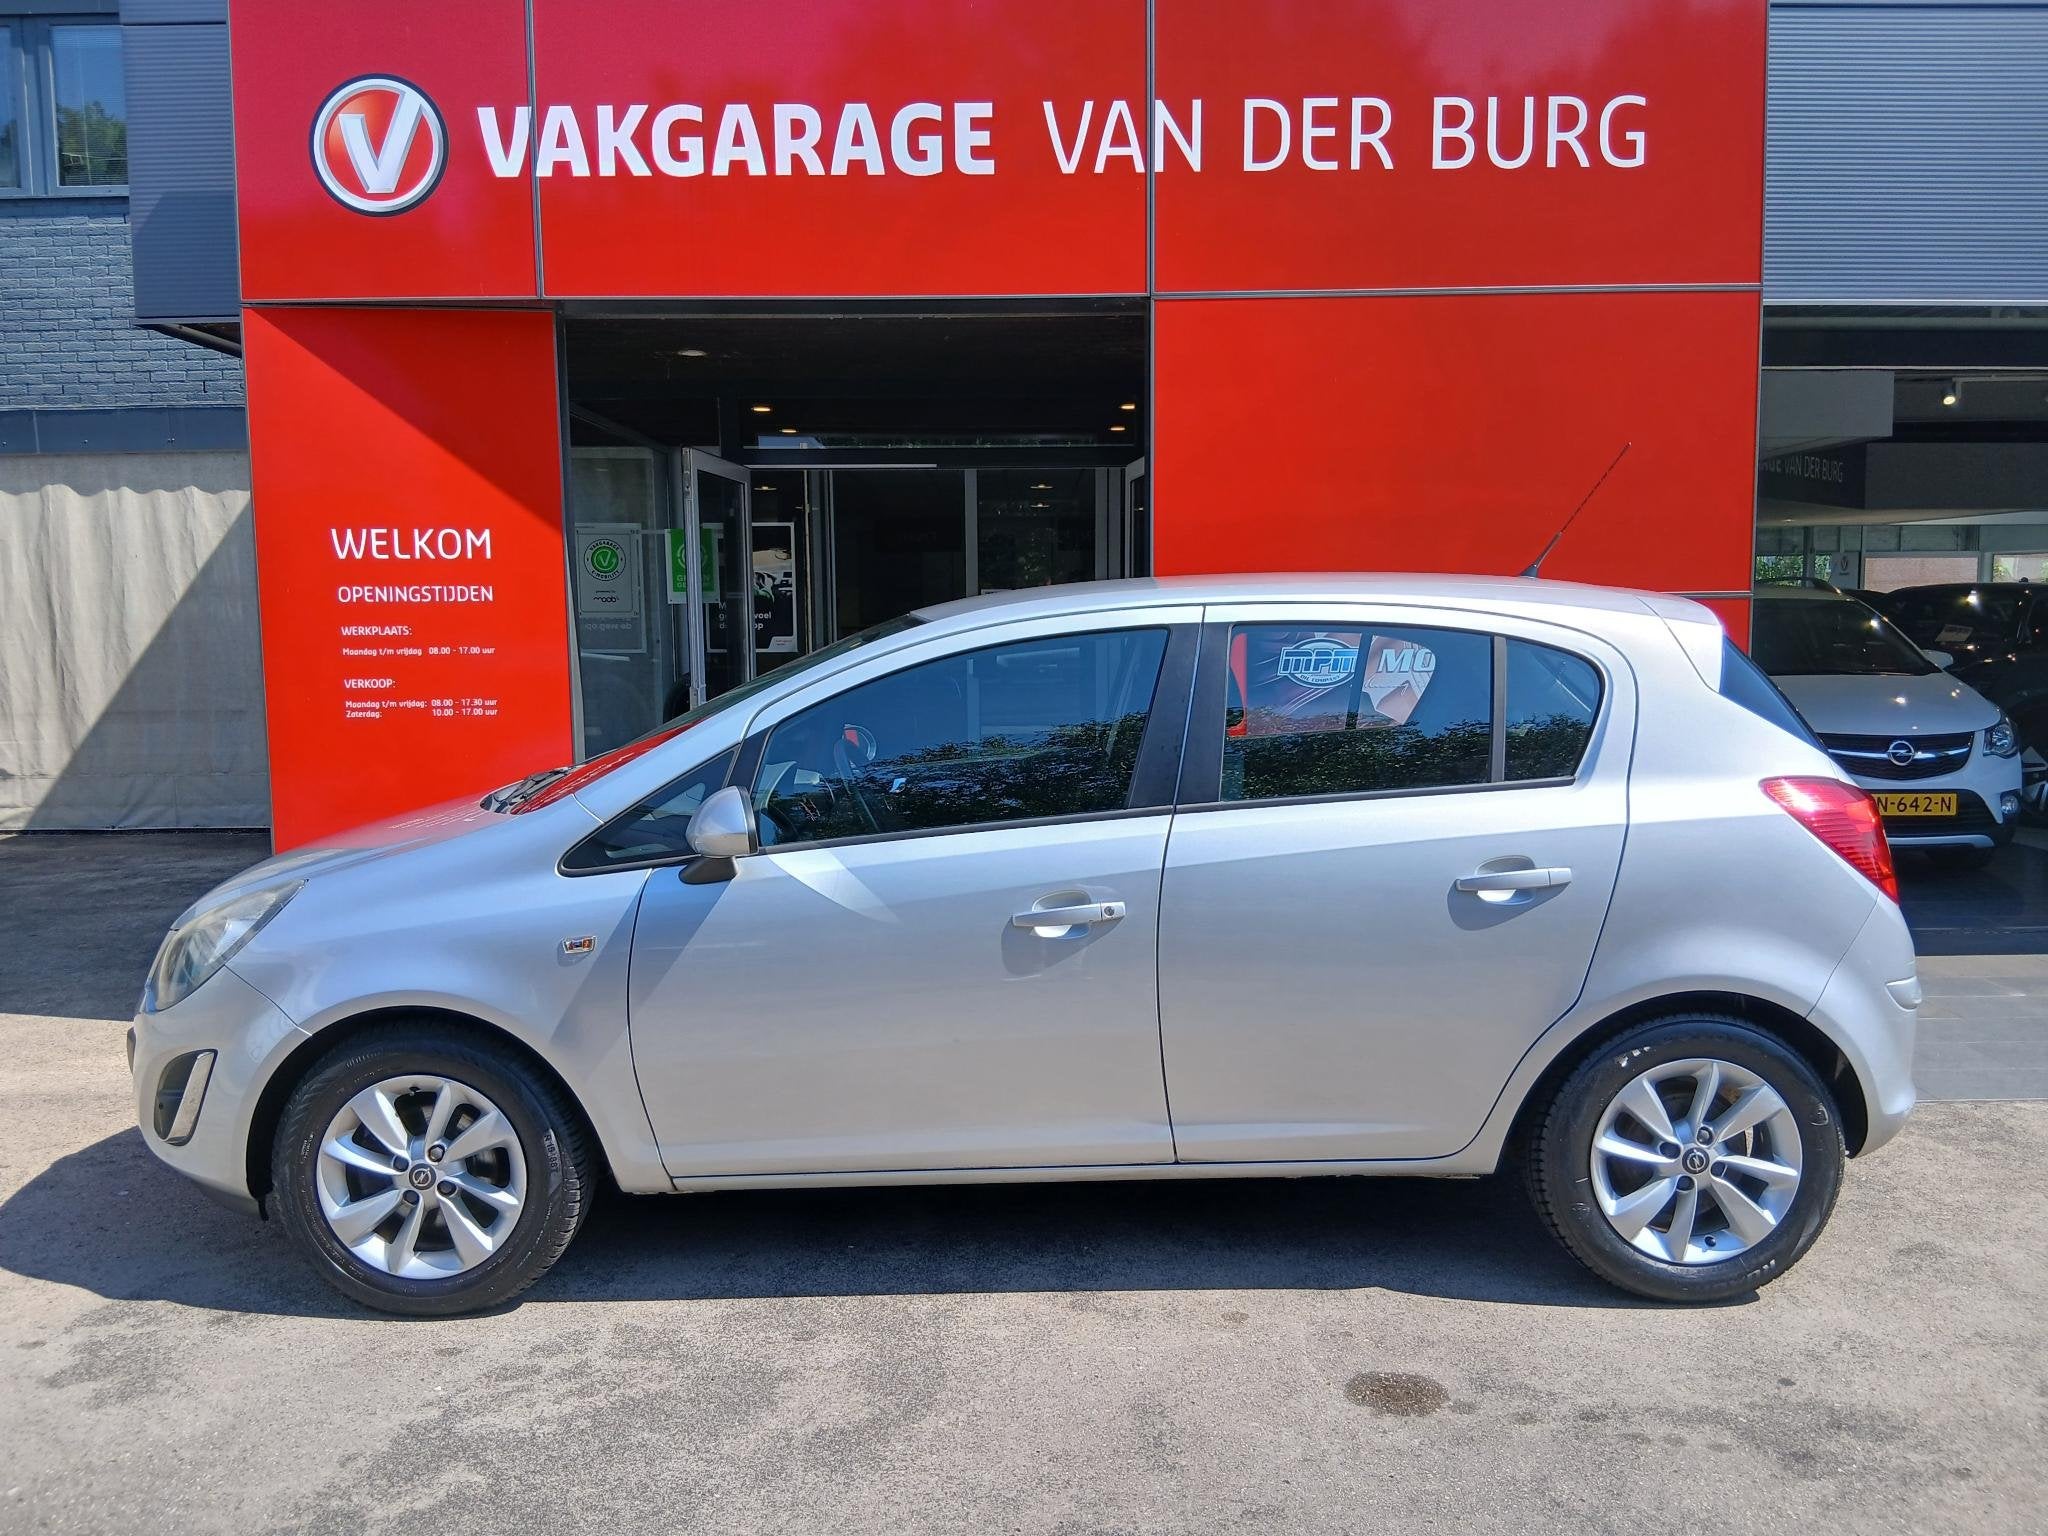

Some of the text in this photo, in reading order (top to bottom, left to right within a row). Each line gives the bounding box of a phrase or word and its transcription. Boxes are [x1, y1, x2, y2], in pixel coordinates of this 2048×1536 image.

[477, 94, 1647, 178] VAKGARAGE VAN DER BURG
[1804, 456, 1820, 479] DER
[1822, 459, 1844, 483] BURG
[330, 528, 493, 560] WELKOM
[337, 585, 494, 603] OPENINGSTIJDEN
[341, 625, 413, 637] WERKPLAATS:
[342, 647, 377, 657] Maandag
[379, 647, 394, 656] t/m
[396, 647, 422, 657] vrijdag
[428, 646, 451, 655] 08.00
[458, 646, 481, 655] 17.00
[482, 647, 496, 655] uur
[344, 677, 396, 689] VERKOOP:
[345, 699, 380, 709] Maandag
[382, 699, 397, 708] t/m
[399, 699, 428, 709] vrijdag:
[431, 698, 453, 707] 08.00
[461, 697, 483, 707] 17.30
[484, 698, 498, 707] uur
[346, 707, 383, 719] Zaterdag:
[432, 707, 454, 717] 10.00
[462, 707, 483, 716] 17.00
[484, 708, 498, 716] uur
[1876, 796, 1953, 813] N-642-N
